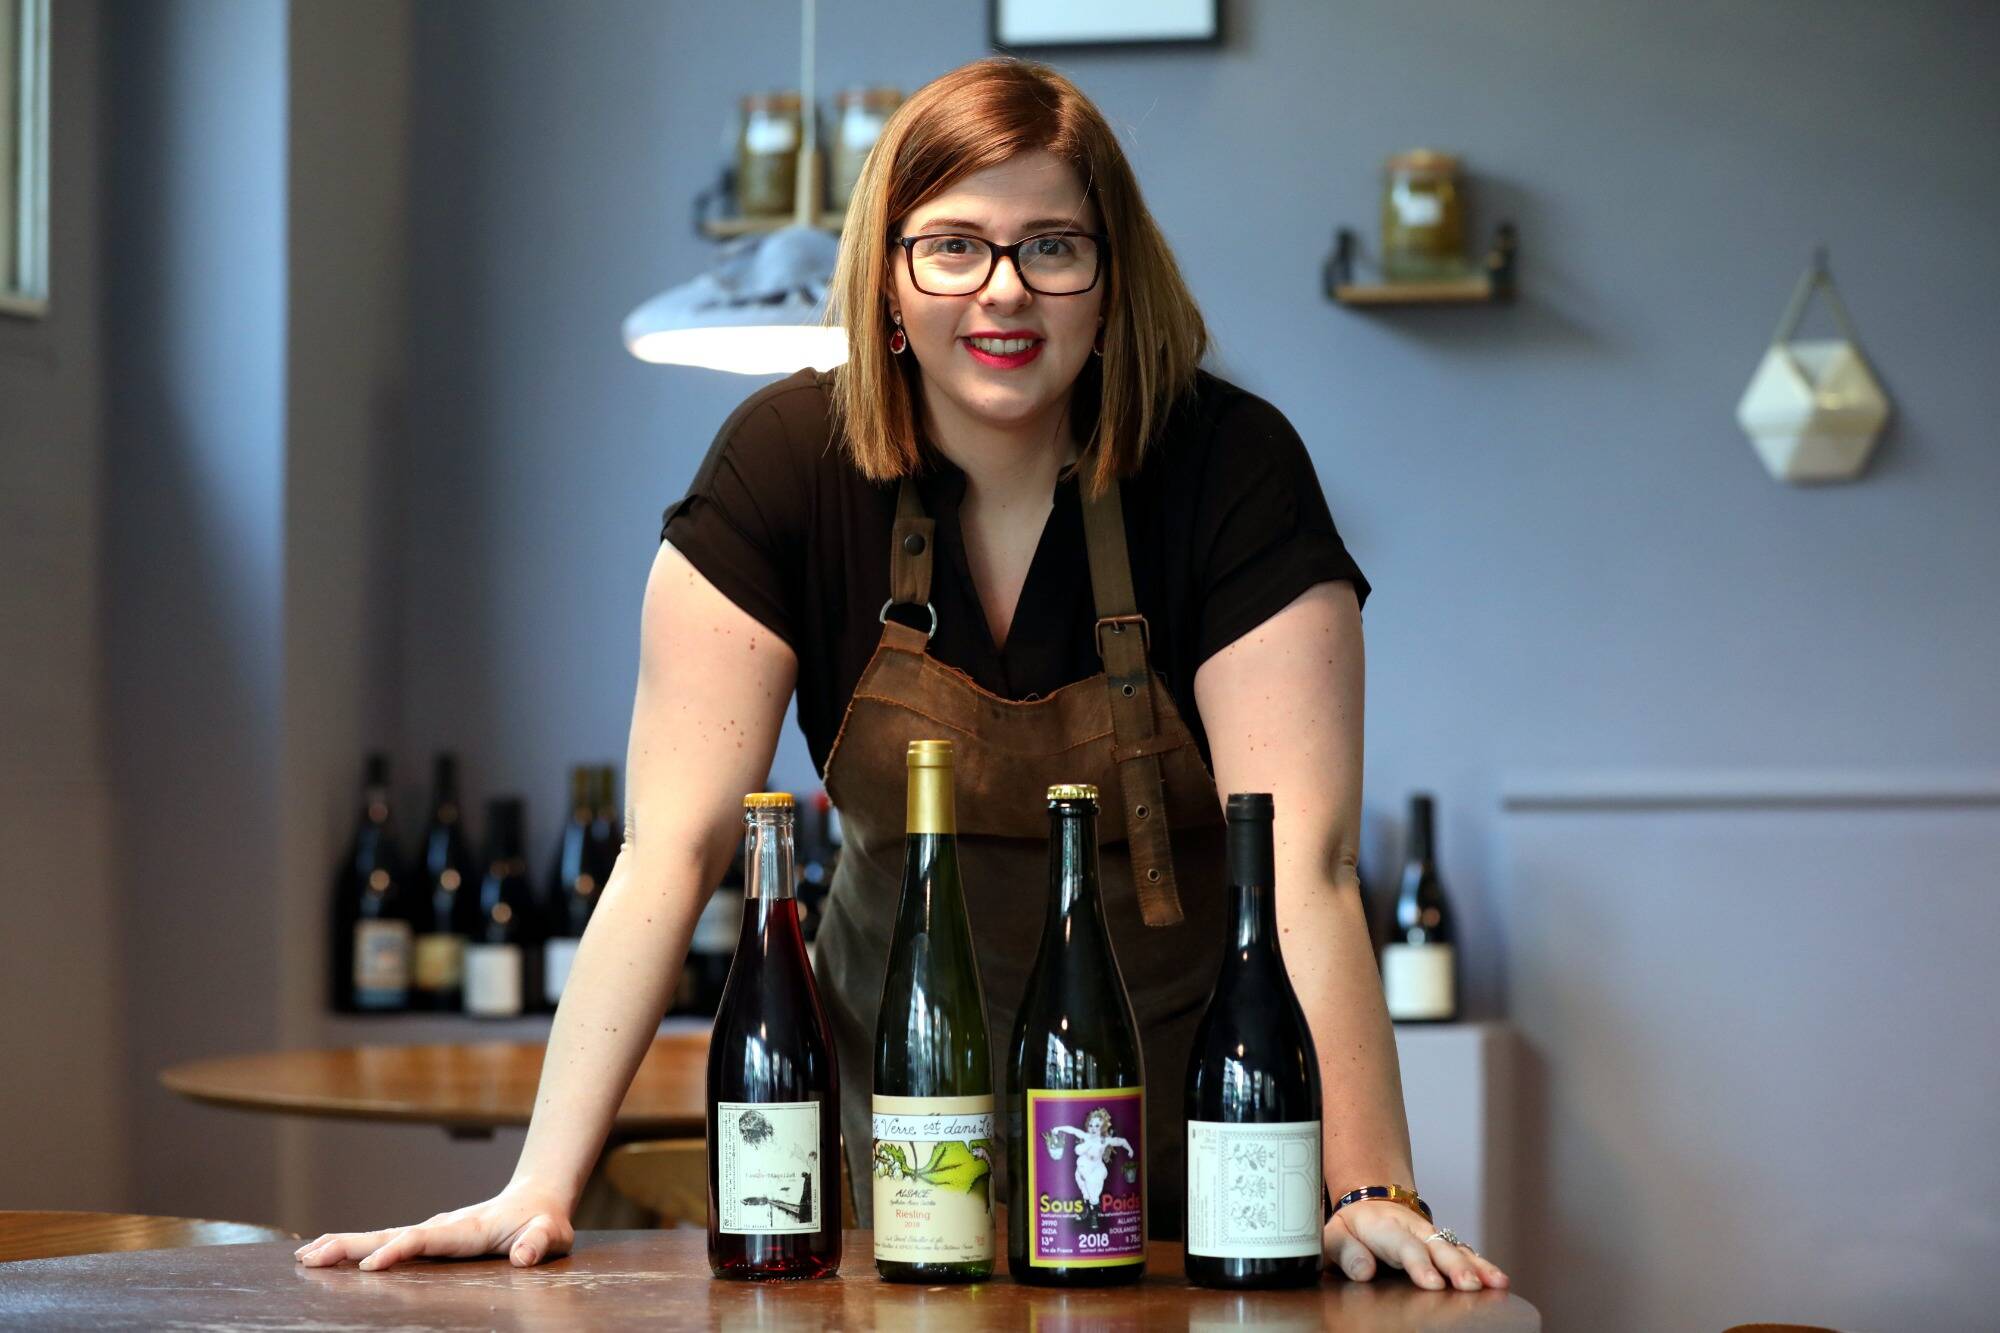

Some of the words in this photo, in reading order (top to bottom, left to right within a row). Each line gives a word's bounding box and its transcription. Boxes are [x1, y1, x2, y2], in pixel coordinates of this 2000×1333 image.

[881, 1119, 917, 1136] Verre
[923, 1120, 942, 1131] est
[943, 1118, 976, 1135] dans
[895, 1188, 933, 1198] ALSACE
[1040, 1195, 1083, 1213] Sous
[1102, 1193, 1141, 1212] Poids
[895, 1209, 931, 1220] Riesling
[1079, 1234, 1109, 1248] 2018
